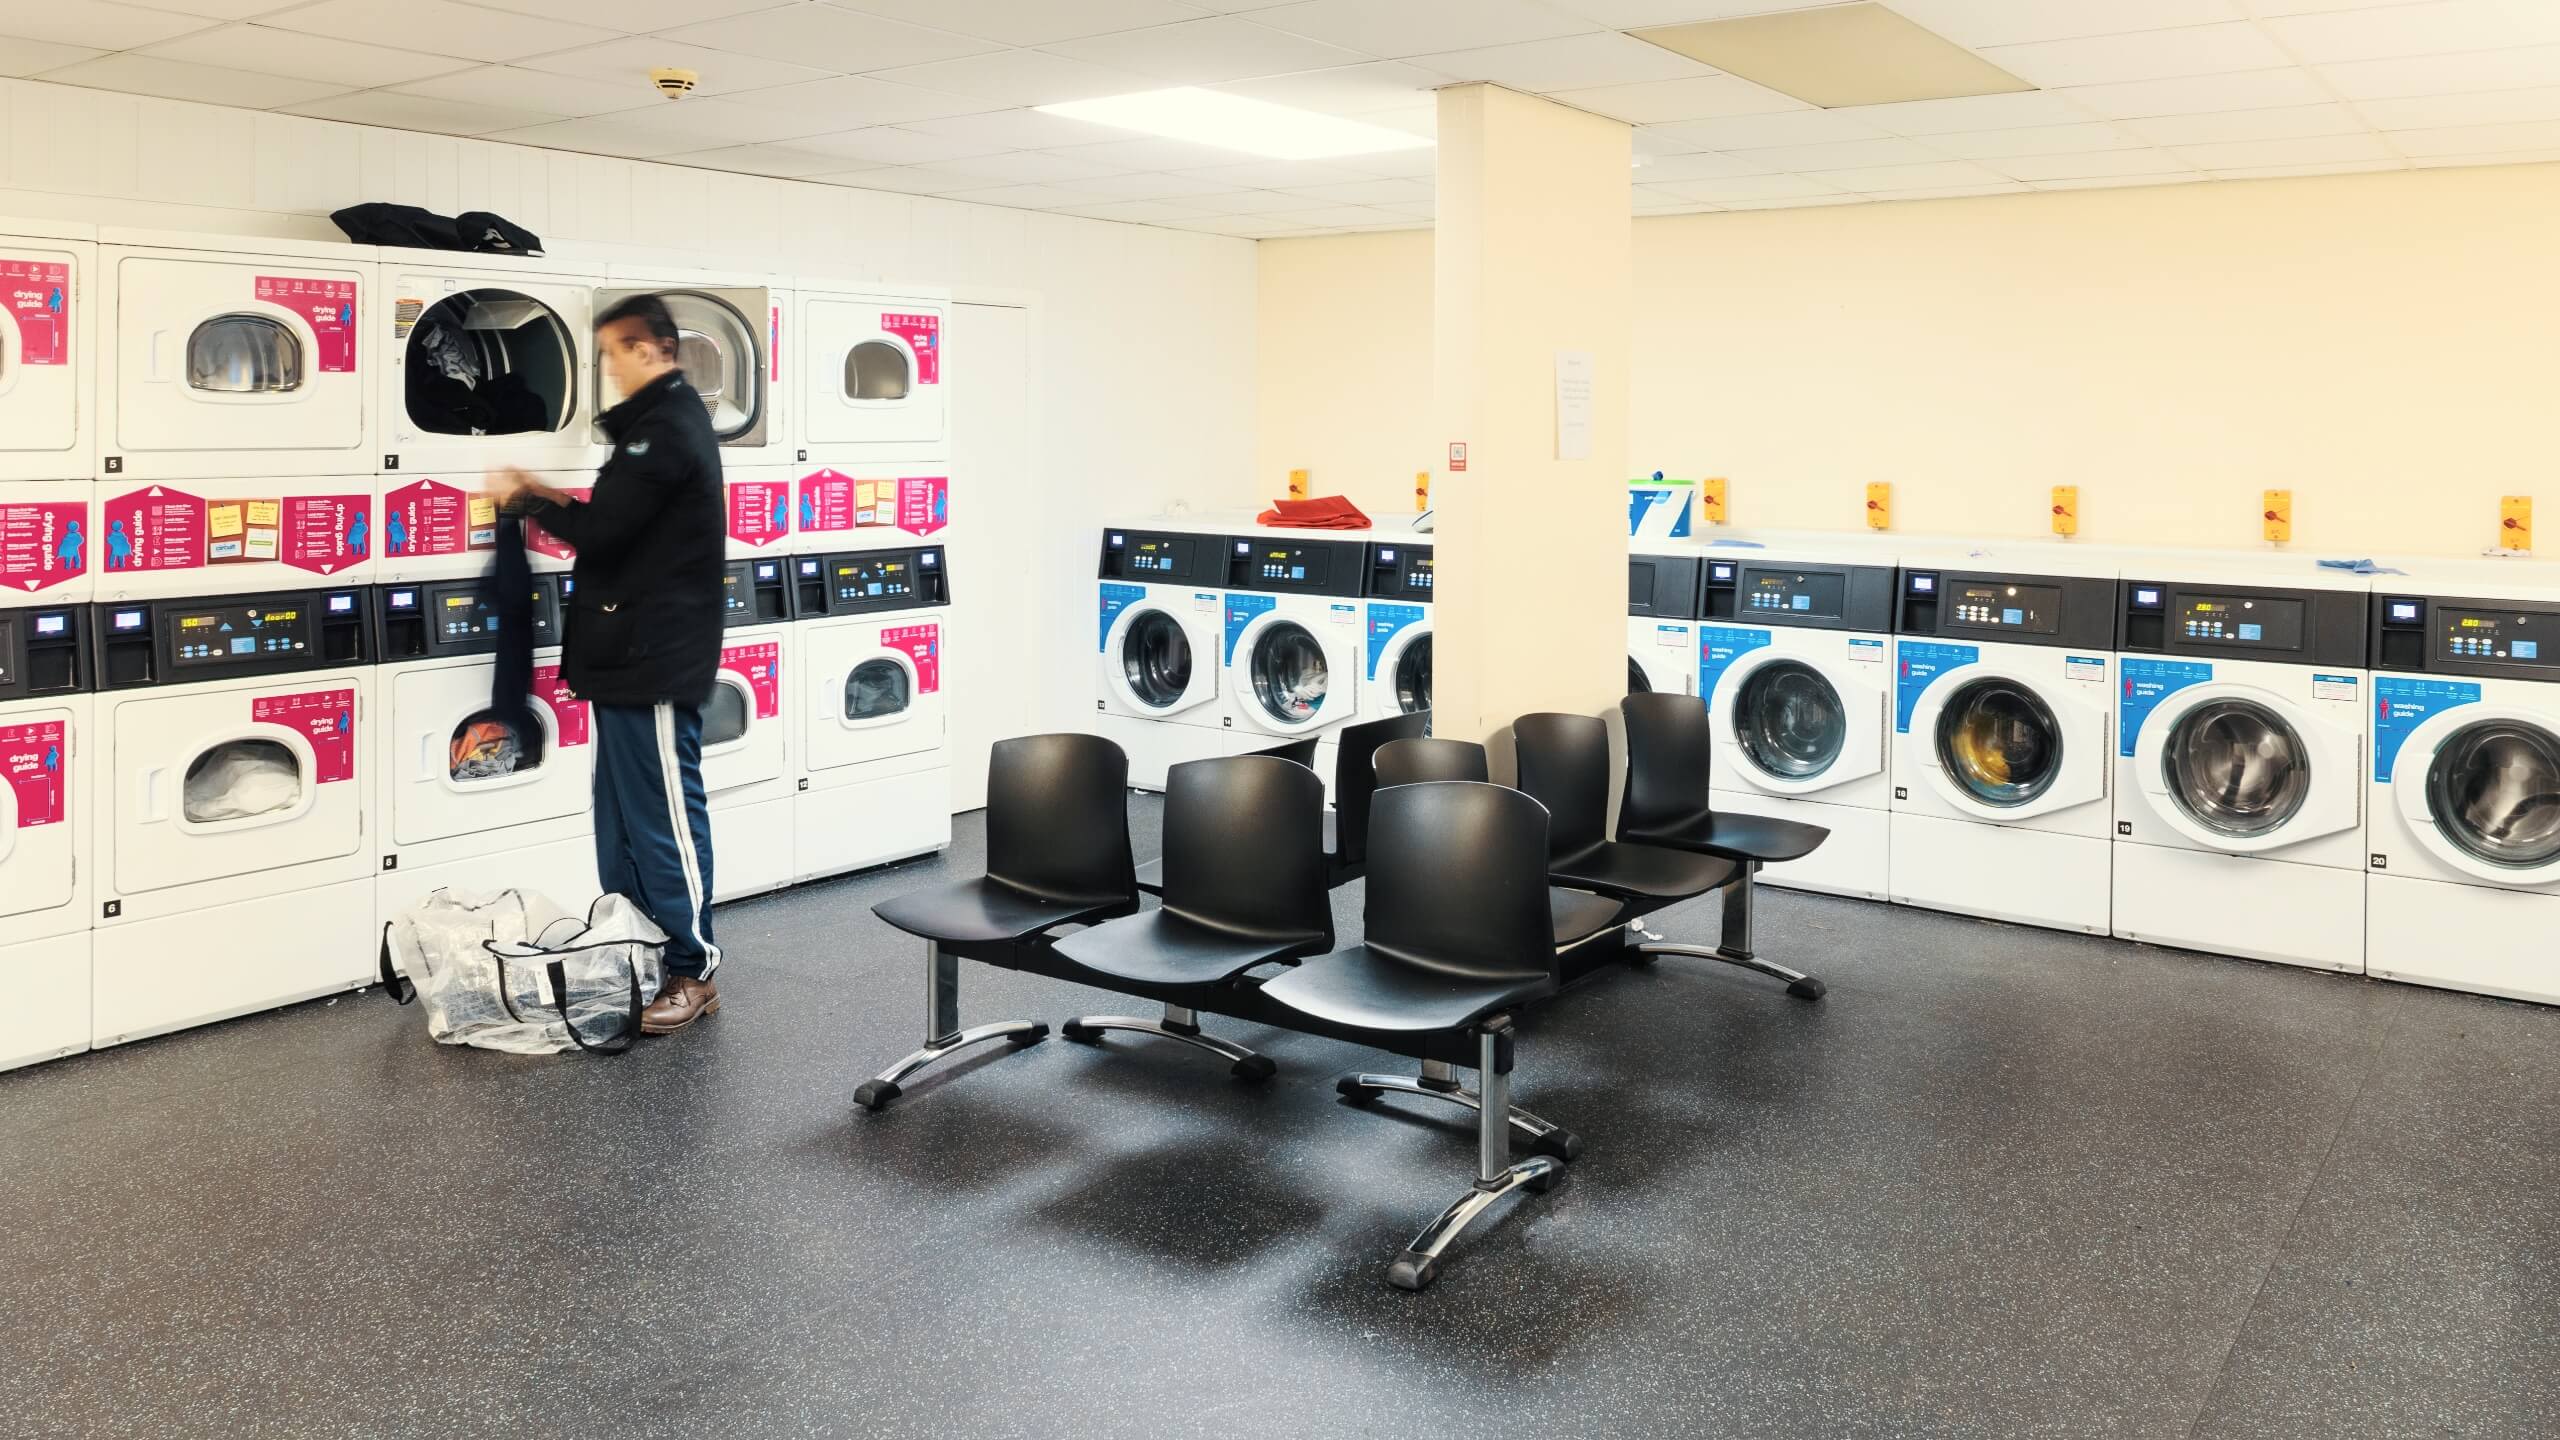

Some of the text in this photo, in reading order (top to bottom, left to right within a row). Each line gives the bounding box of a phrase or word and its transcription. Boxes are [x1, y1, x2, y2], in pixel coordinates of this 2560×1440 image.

[13, 289, 43, 300] drying
[16, 300, 43, 309] guide
[312, 305, 336, 315] drying
[314, 314, 336, 323] guide
[109, 459, 117, 469] 5
[387, 457, 394, 467] 7
[334, 503, 345, 557] drying guide
[408, 501, 416, 553] drying guide
[42, 511, 55, 571] drying guide
[132, 509, 145, 567] drying guide
[1911, 663, 1936, 672] washing
[2136, 681, 2165, 692] washing
[2136, 688, 2156, 697] guide
[2393, 702, 2425, 713] washing
[2393, 710, 2415, 719] guide
[310, 717, 334, 727] drying
[312, 725, 334, 735] guide
[9, 753, 39, 764] drying
[12, 762, 39, 774] guide
[2120, 824, 2131, 832] 19
[385, 858, 392, 867] 8
[2372, 856, 2385, 866] 20
[107, 904, 116, 913] 6
